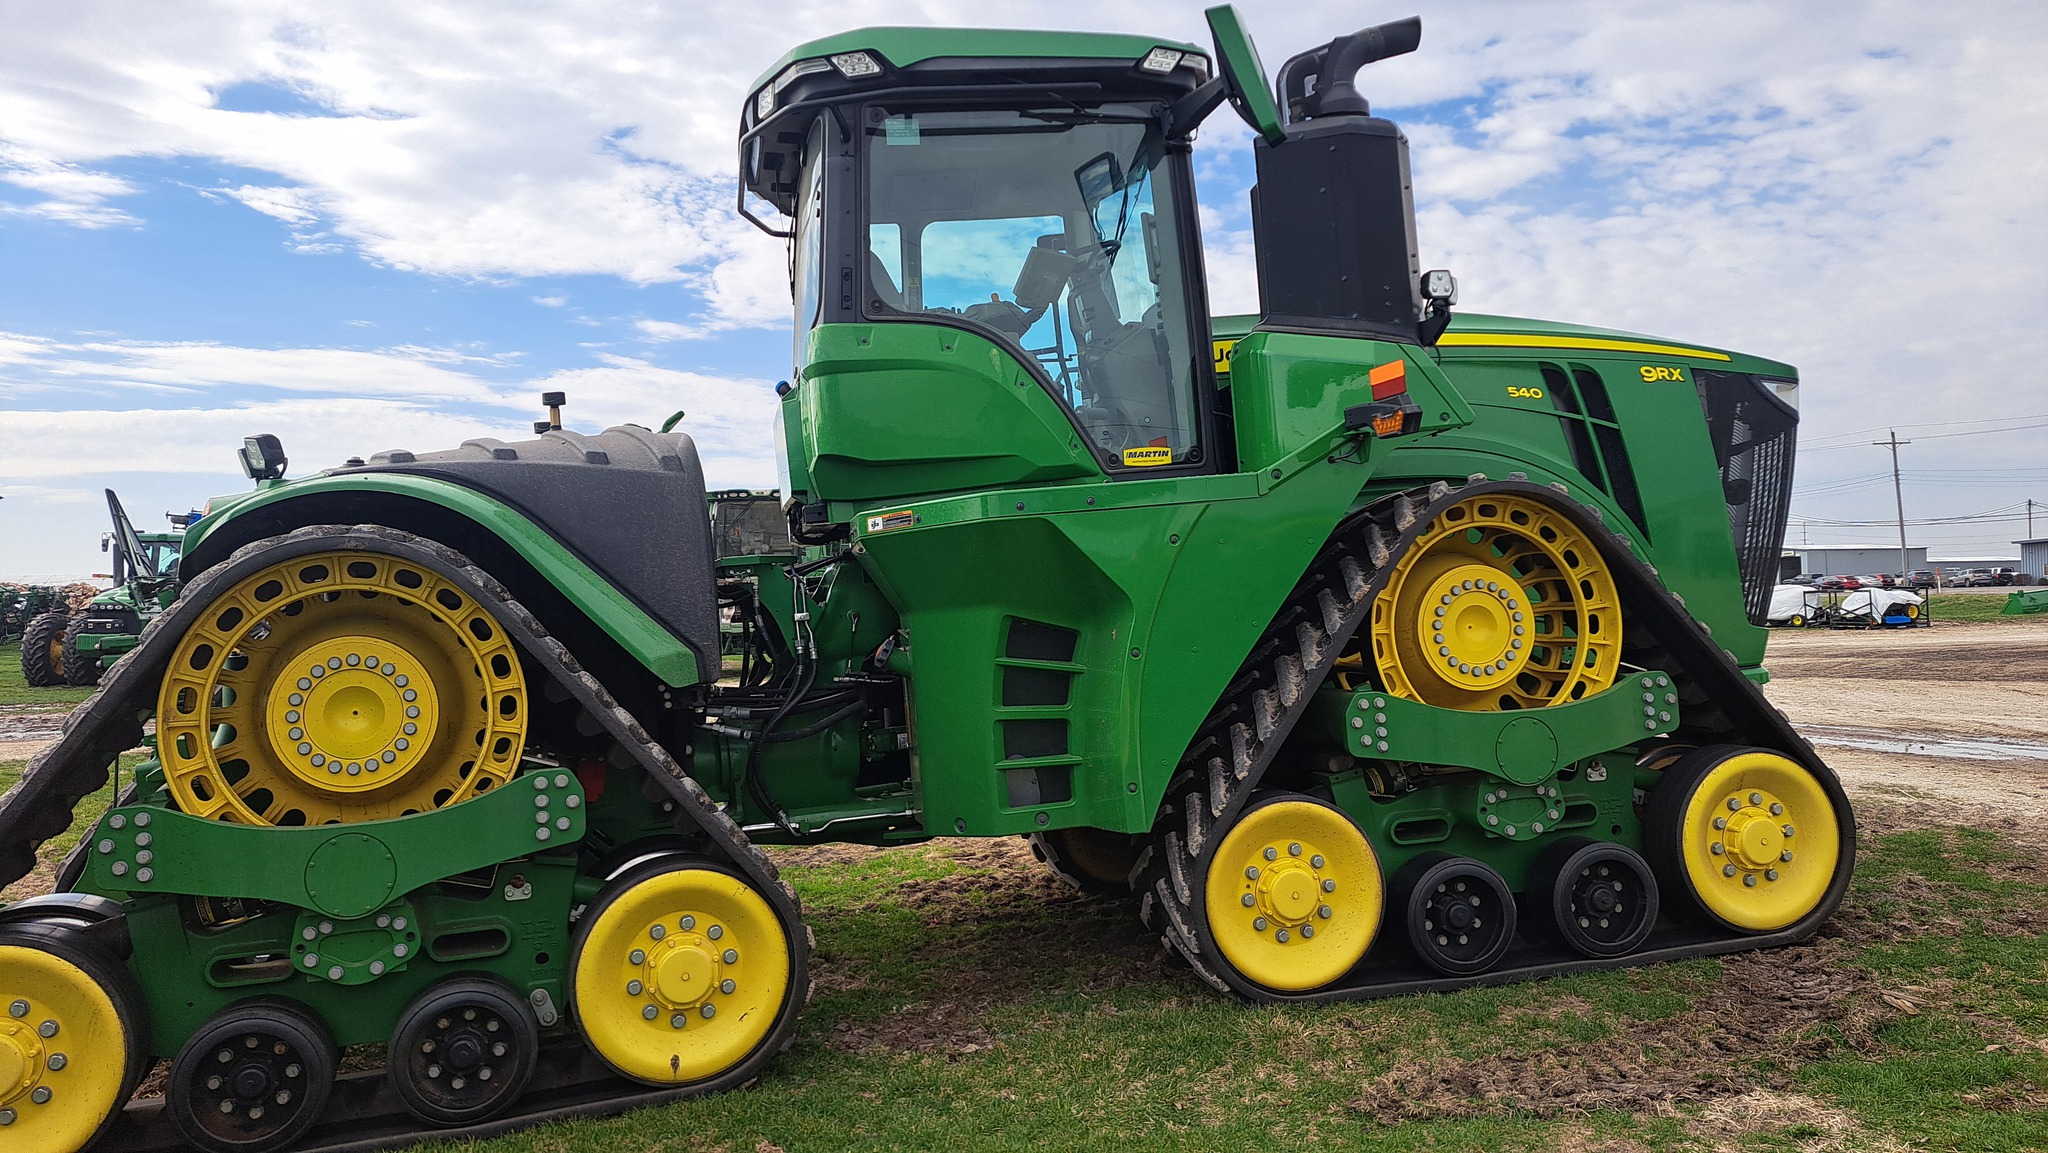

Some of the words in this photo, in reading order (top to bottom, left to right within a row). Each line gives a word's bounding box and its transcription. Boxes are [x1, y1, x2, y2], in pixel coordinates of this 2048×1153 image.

[1639, 365, 1686, 383] 9RX
[1506, 386, 1543, 399] 540
[1126, 450, 1169, 459] MARTIN
